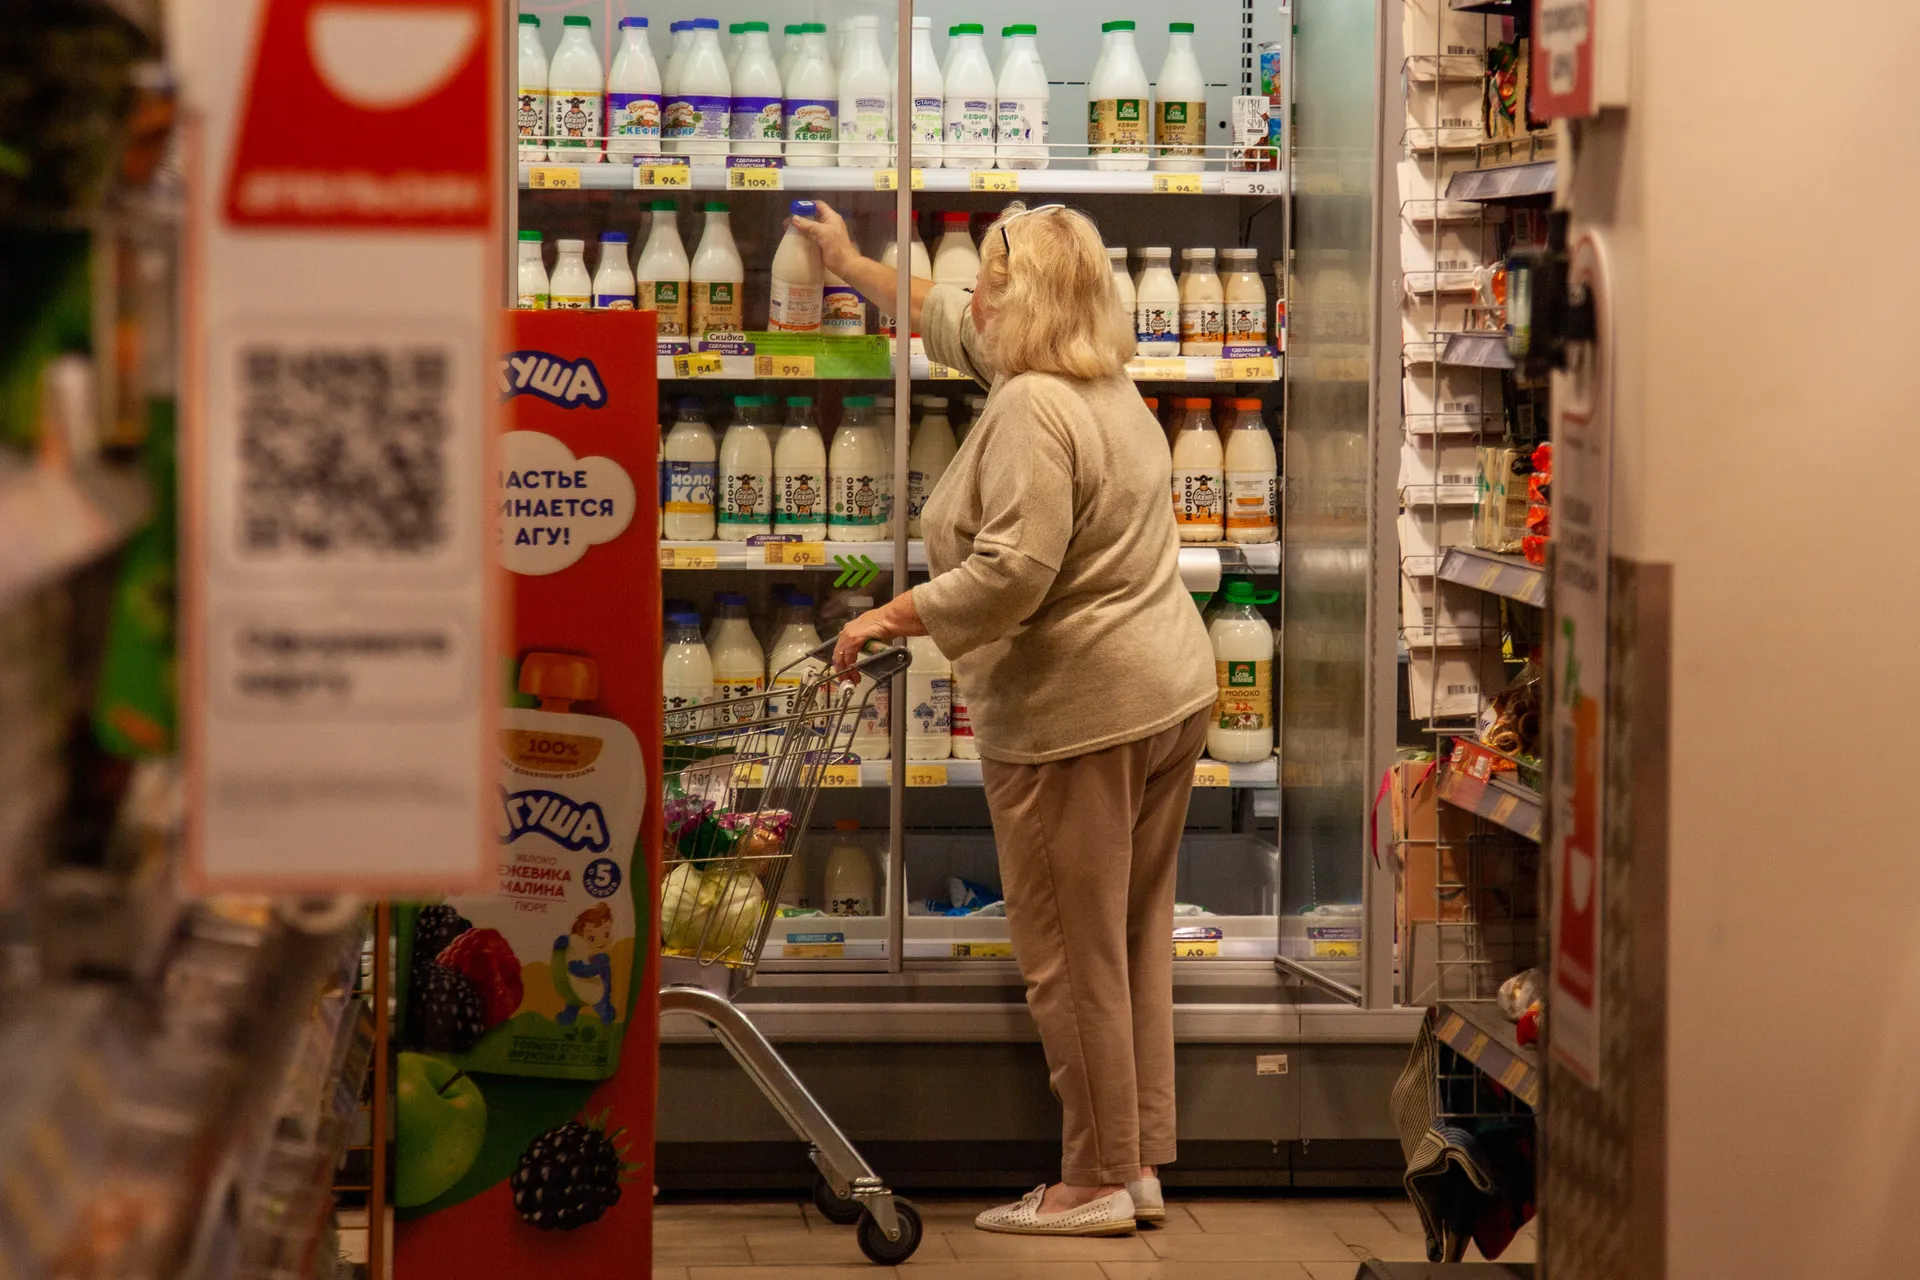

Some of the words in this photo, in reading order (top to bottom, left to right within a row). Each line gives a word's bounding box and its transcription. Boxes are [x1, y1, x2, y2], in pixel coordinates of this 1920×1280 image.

[795, 132, 831, 141] КЕФИР
[662, 177, 676, 185] 96
[1248, 184, 1265, 193] 39
[823, 319, 862, 327] МОЛОКО
[697, 365, 711, 374] 84
[782, 366, 800, 376] 99
[1246, 367, 1260, 377] 57
[671, 474, 711, 486] МОЛО
[671, 486, 711, 505] КО
[785, 475, 793, 521] МОЛОКО
[846, 477, 854, 522] МОЛОКО
[515, 527, 571, 546] АГУ!
[685, 557, 702, 568] 79
[793, 552, 811, 563] 69
[528, 739, 579, 756] 100%
[823, 775, 844, 785] 139
[911, 775, 933, 785] 132
[515, 853, 557, 865] ЯБЛОКО
[594, 864, 613, 888] 5
[501, 880, 565, 898] МАЛИНА
[514, 901, 548, 913] ПЮРЕ
